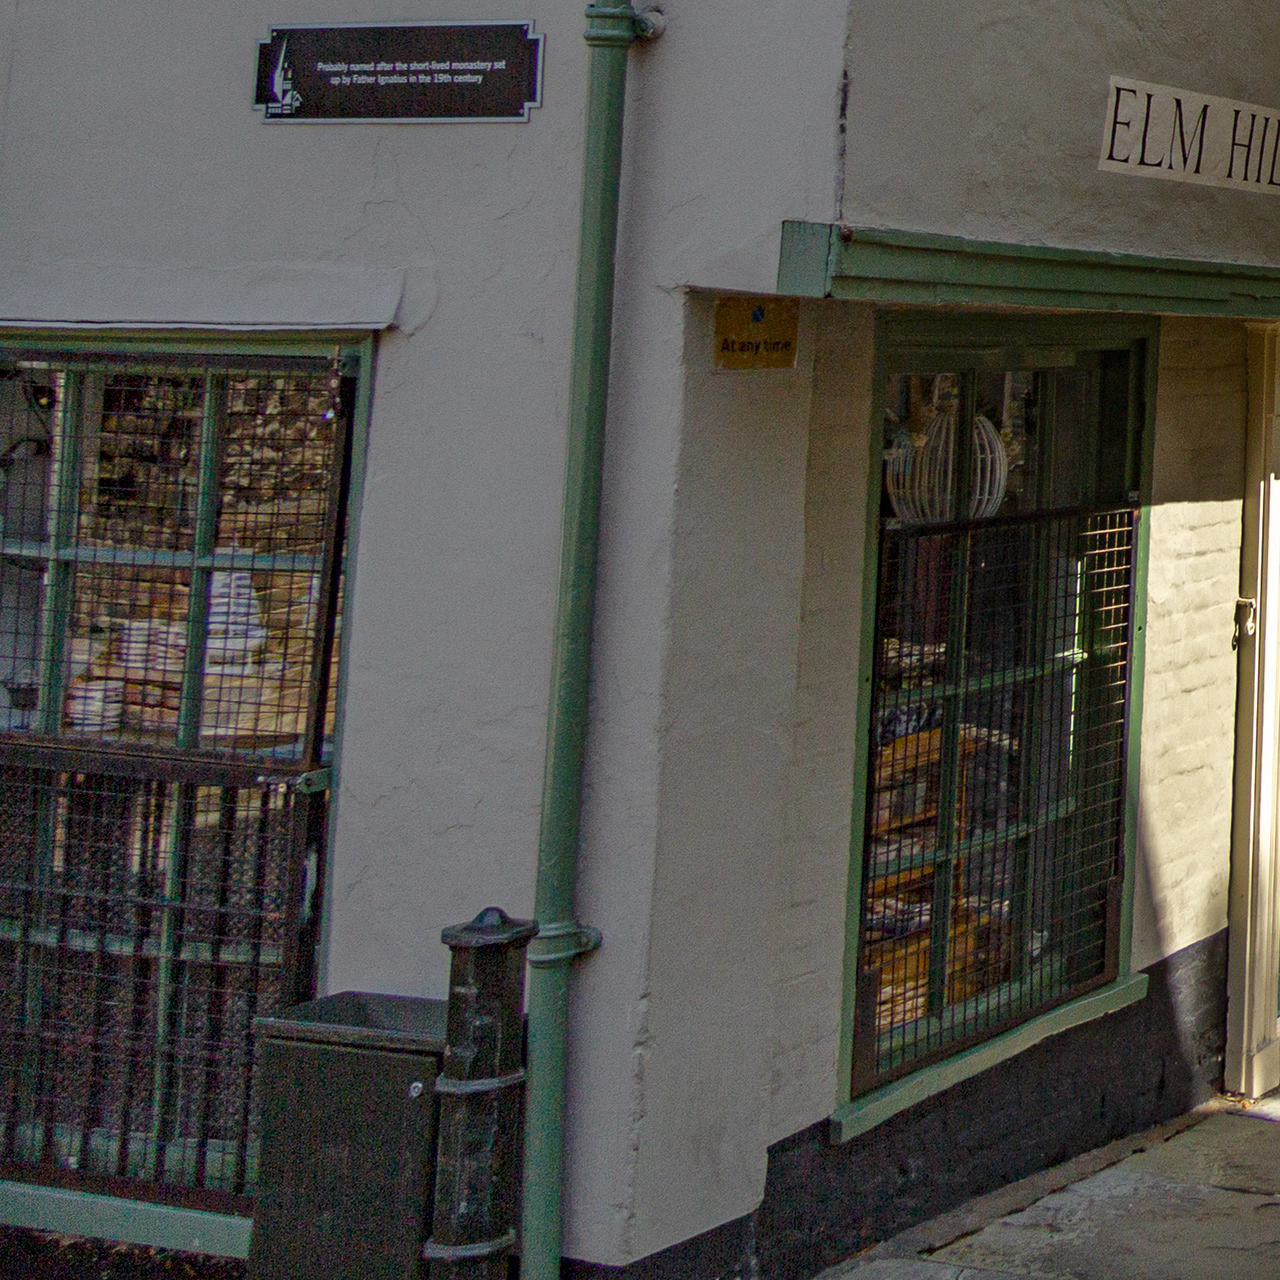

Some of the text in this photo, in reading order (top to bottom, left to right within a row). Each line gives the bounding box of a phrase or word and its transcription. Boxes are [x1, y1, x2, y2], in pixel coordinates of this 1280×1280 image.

[317, 60, 506, 73] Probably named after the short-lived monastery set
[330, 73, 483, 86] up by Father Ignatius in the 19th century
[1106, 86, 1211, 174] ELM
[721, 338, 791, 355] At any time
